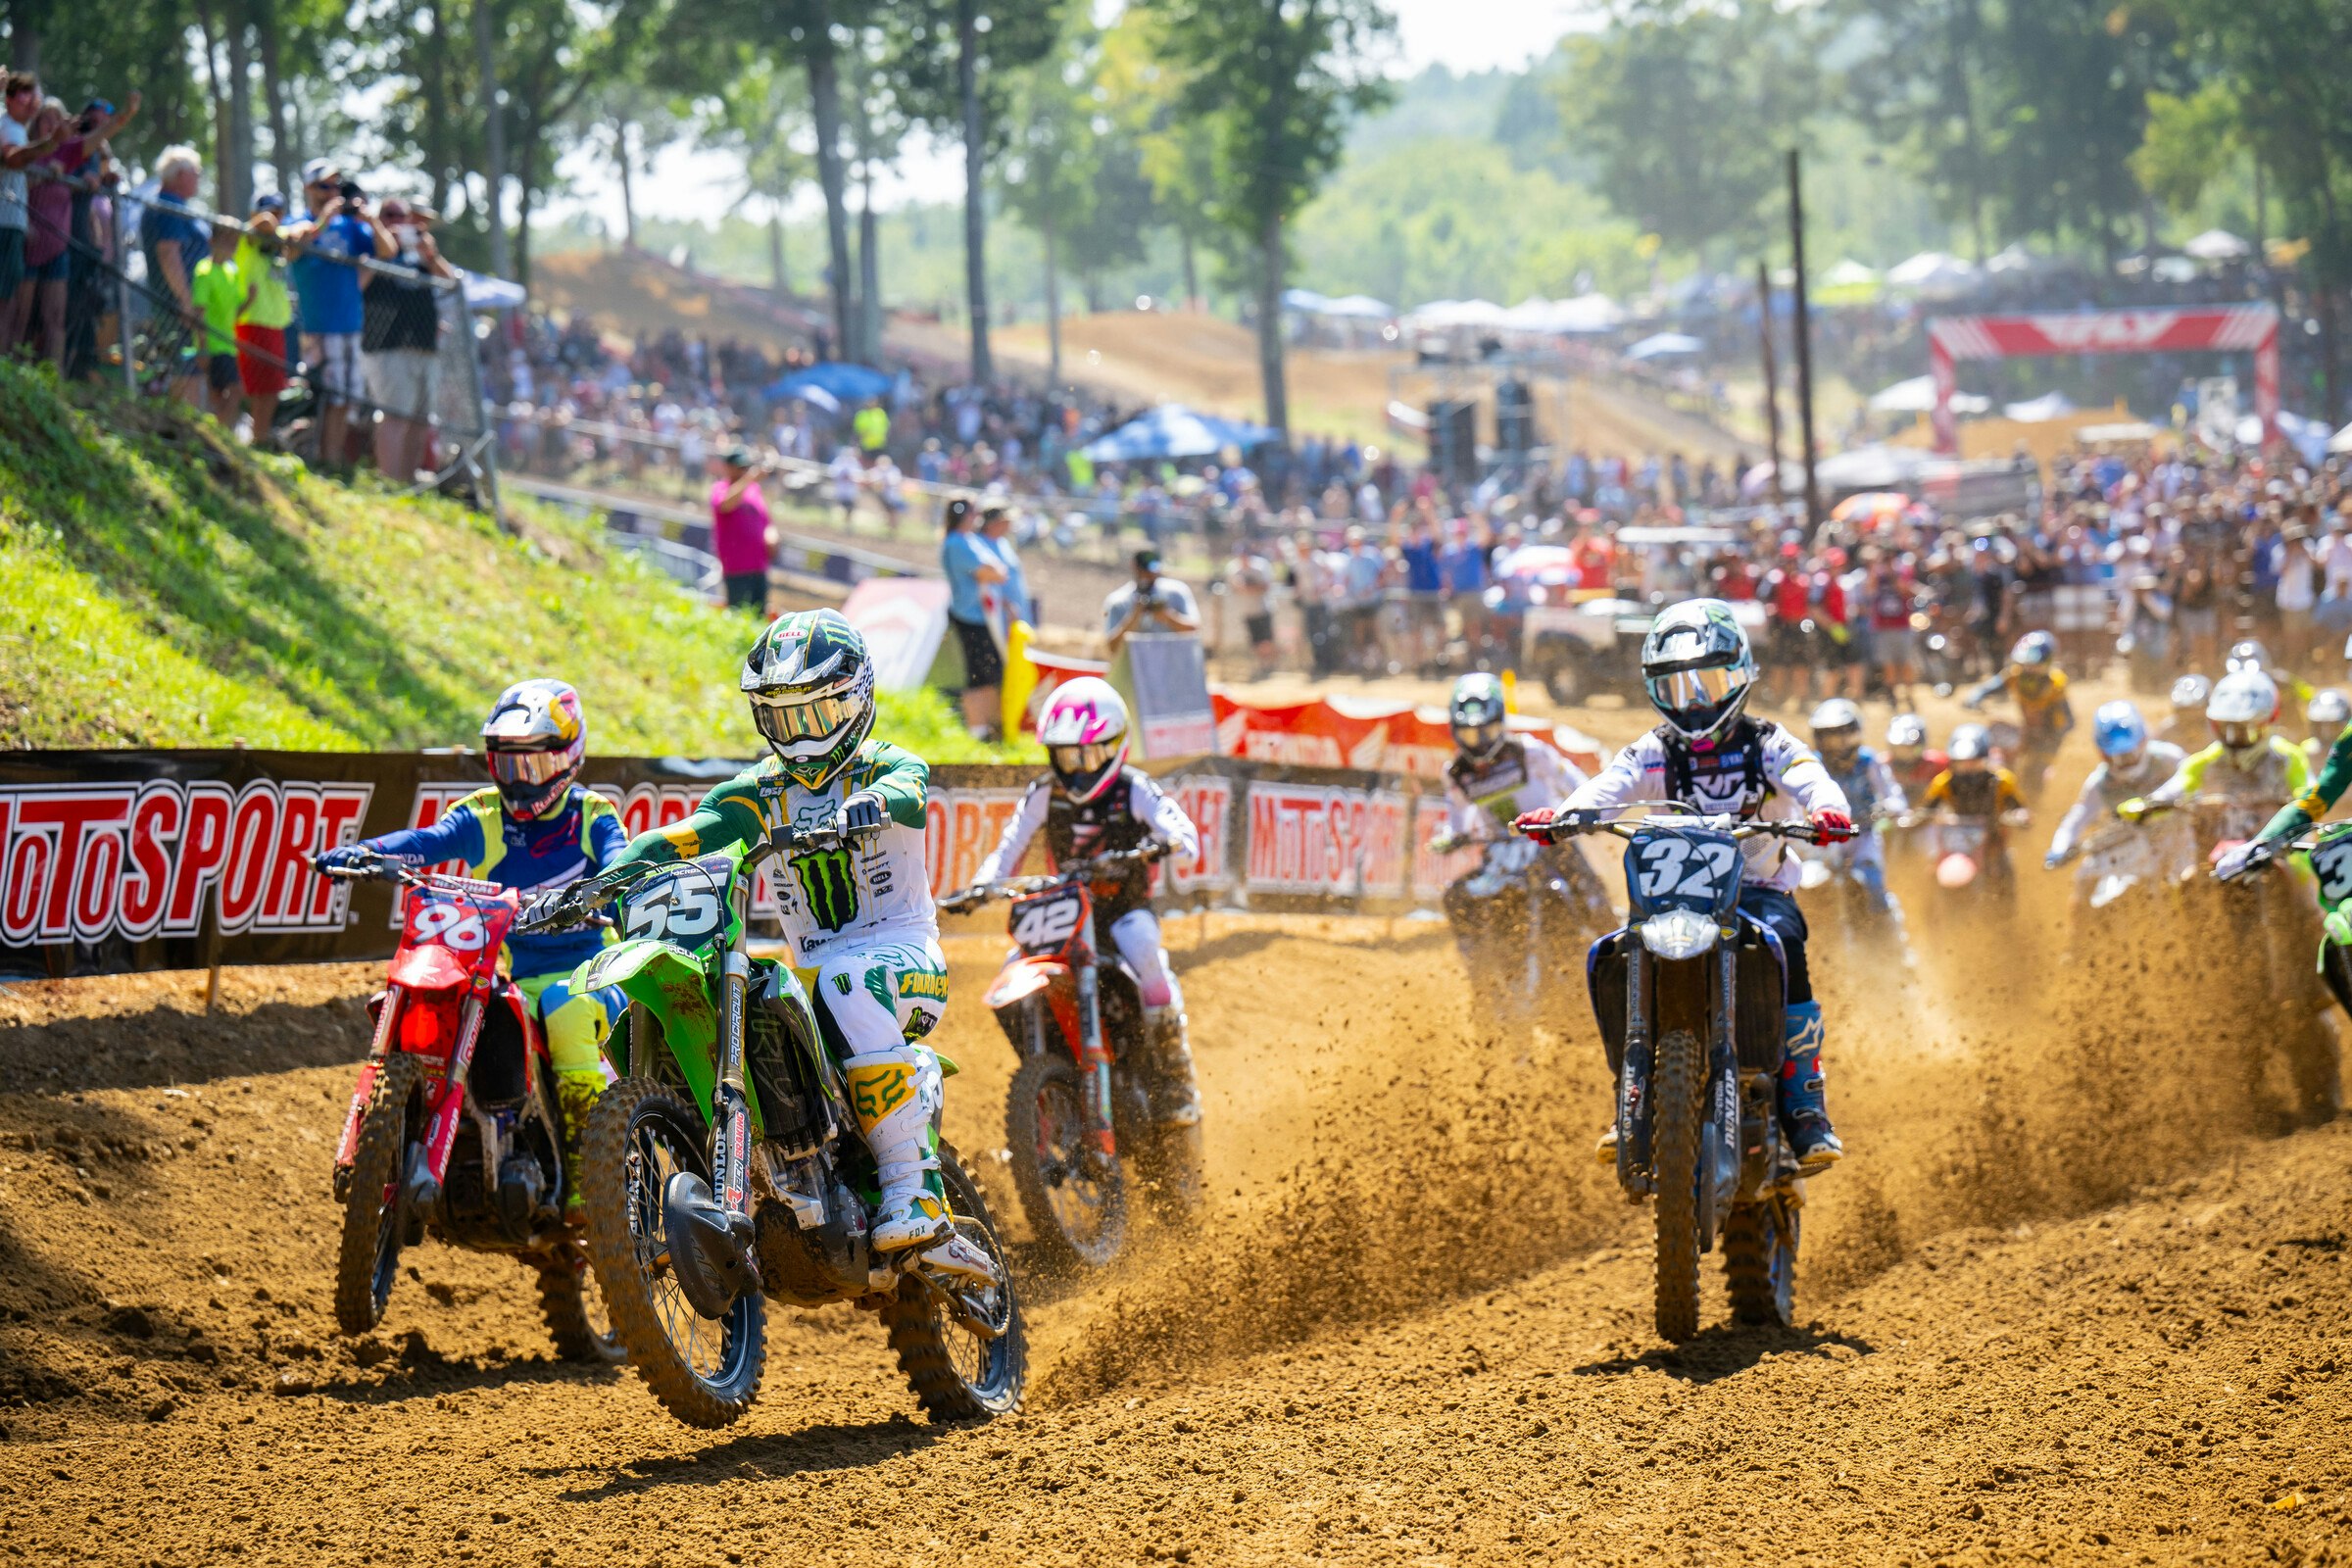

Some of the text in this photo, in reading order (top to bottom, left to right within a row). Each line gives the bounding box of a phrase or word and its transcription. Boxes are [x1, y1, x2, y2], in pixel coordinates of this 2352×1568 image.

[779, 630, 803, 639] BELL
[838, 763, 872, 780] Kawasa
[0, 783, 370, 943] OTOSPORT
[399, 854, 425, 864] NDA
[1639, 838, 1737, 899] 32
[2319, 844, 2352, 901] 3
[402, 904, 492, 951] 96
[626, 871, 728, 941] 55
[1013, 899, 1079, 948] 42
[730, 982, 744, 1066] PRO CIRCUIT
[735, 1110, 745, 1160] BRAKING
[1724, 1069, 1735, 1149] DUNLOP
[438, 1106, 460, 1180] DUNLOP
[713, 1126, 726, 1209] DUNLOP
[908, 1225, 926, 1241] FOX
